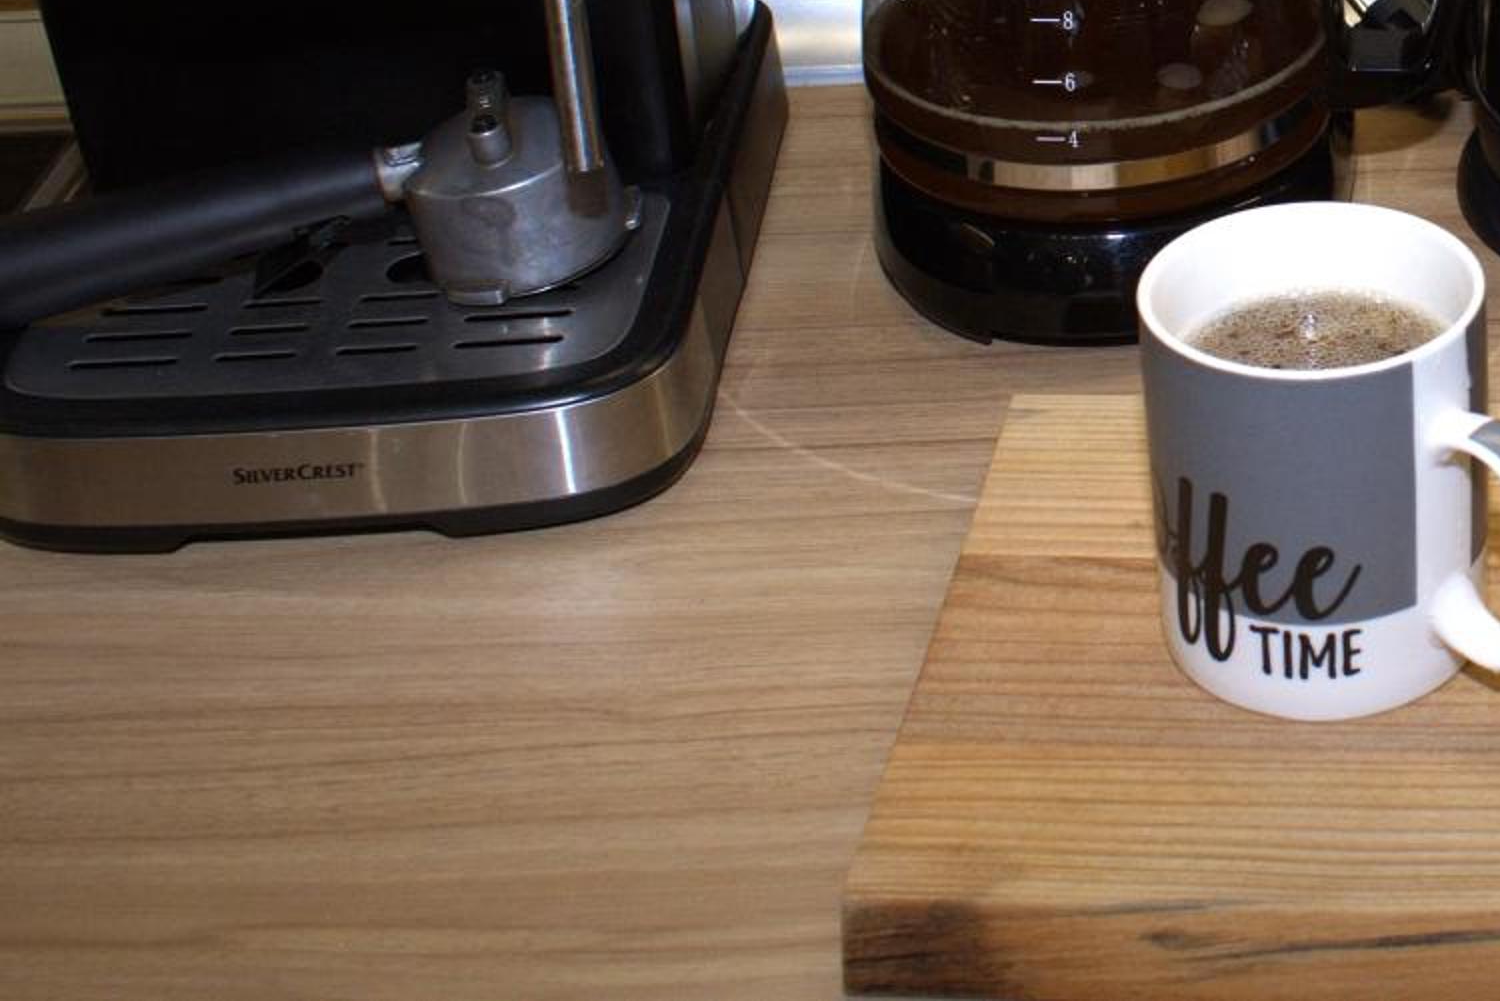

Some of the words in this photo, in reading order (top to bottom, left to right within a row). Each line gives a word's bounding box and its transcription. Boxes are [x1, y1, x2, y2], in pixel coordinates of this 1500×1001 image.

[1062, 11, 1074, 30] 8
[1065, 72, 1076, 92] 6
[1068, 131, 1079, 148] 4
[1164, 476, 1363, 662] ffee
[1249, 624, 1364, 680] TIME
